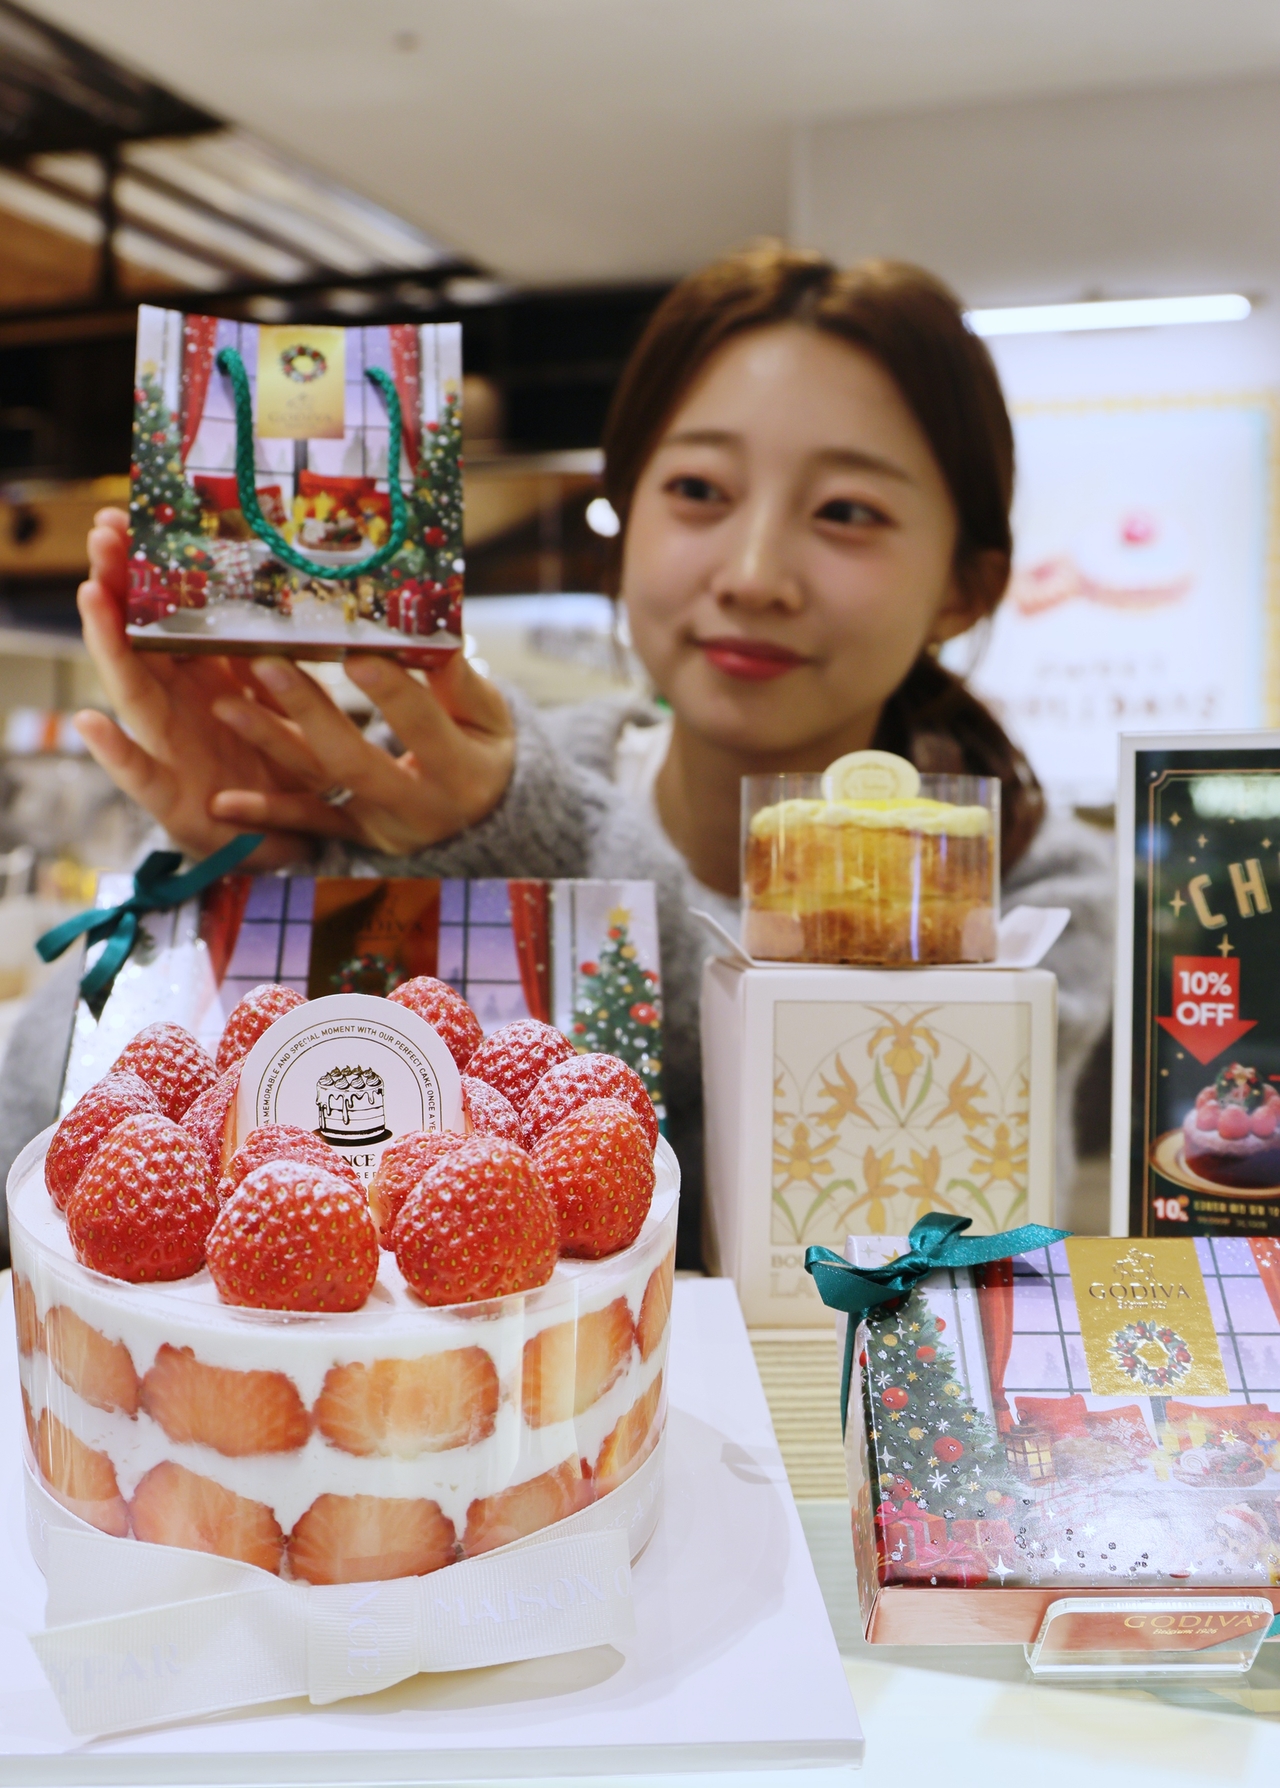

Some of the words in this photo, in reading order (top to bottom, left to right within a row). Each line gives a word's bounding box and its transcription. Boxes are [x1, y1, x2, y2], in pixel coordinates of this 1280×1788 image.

[1188, 858, 1280, 930] CH
[1178, 971, 1232, 997] 10%
[1176, 1001, 1235, 1027] OFF
[263, 1068, 280, 1118] MEMORABLE
[277, 1052, 291, 1069] AND
[290, 1033, 320, 1054] SPECIAL
[321, 1025, 356, 1036] MOMENT
[357, 1025, 377, 1036] WITH
[378, 1031, 395, 1043] OUR
[394, 1040, 423, 1067] PERFECT
[419, 1067, 432, 1089] CAKE
[426, 1090, 436, 1111] ONCE
[1088, 1282, 1192, 1299] GODIVA
[1124, 1615, 1253, 1629] GODIVA
